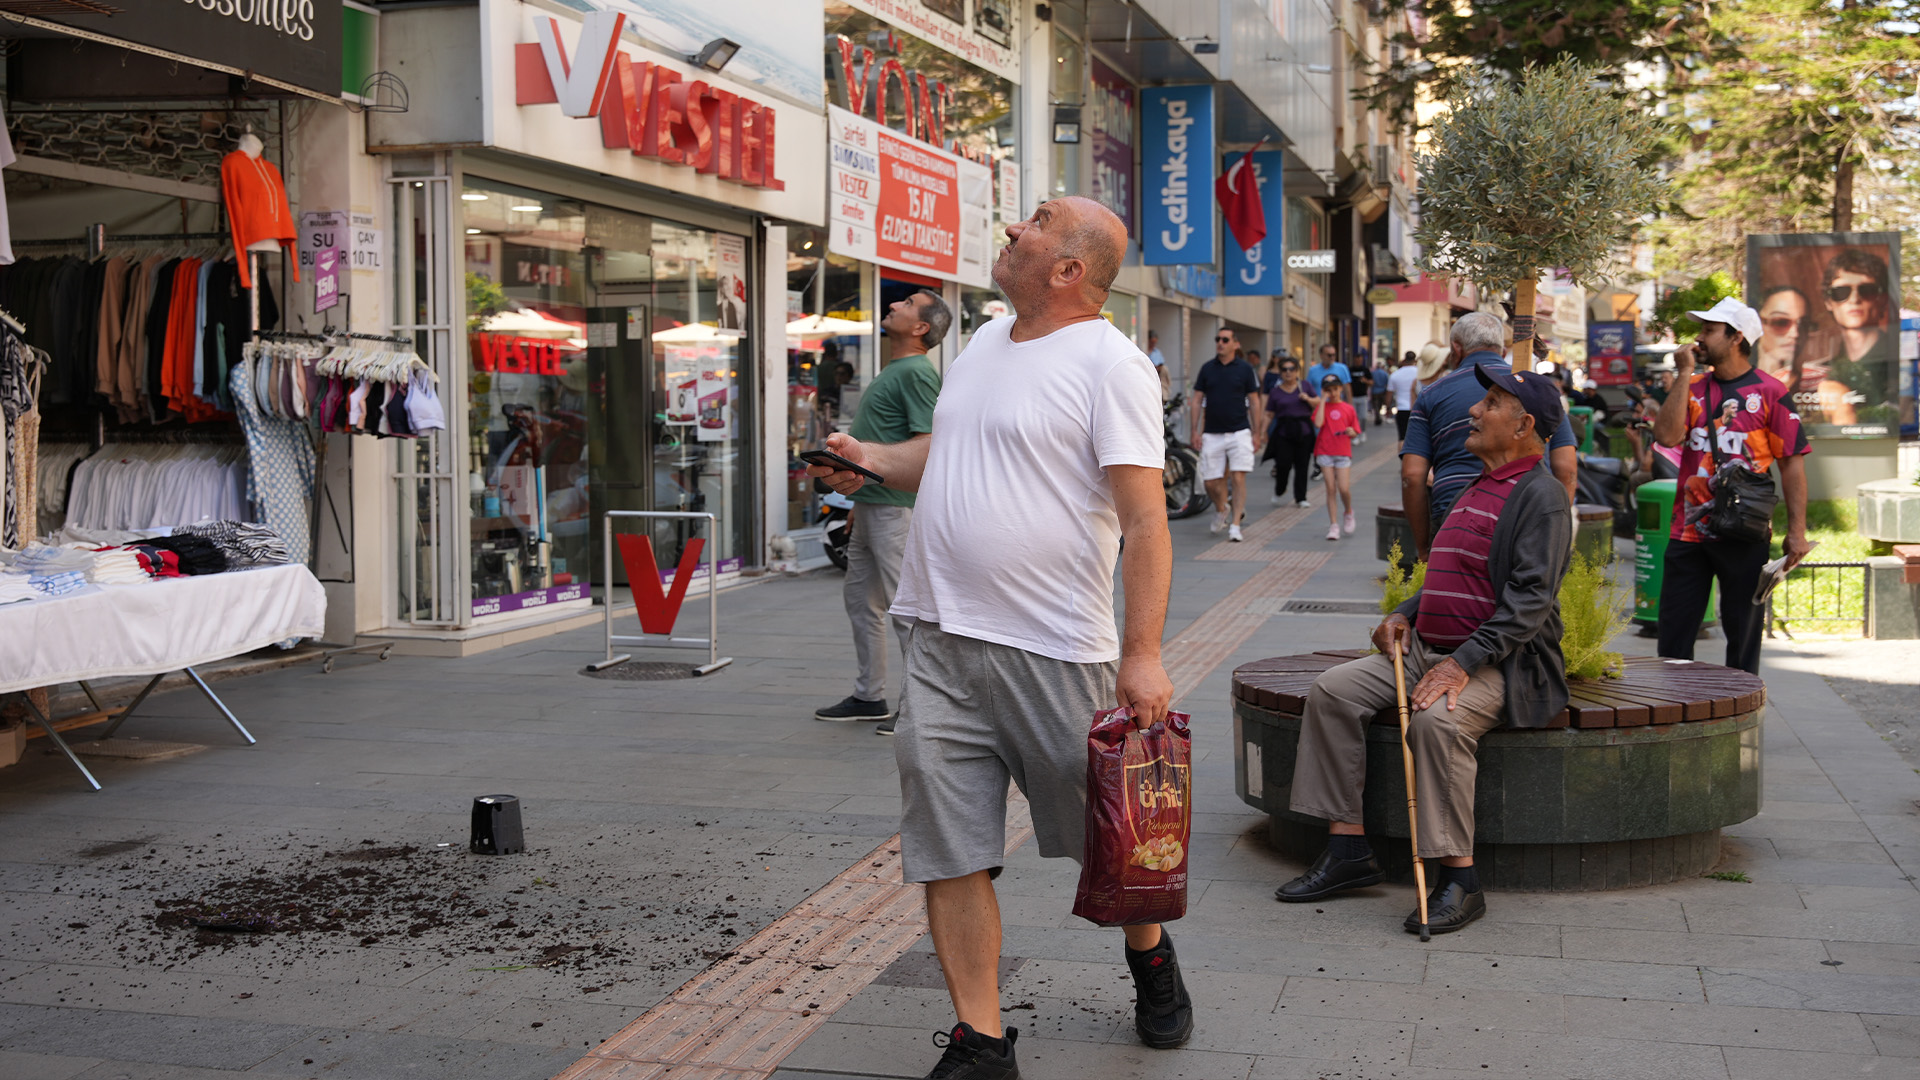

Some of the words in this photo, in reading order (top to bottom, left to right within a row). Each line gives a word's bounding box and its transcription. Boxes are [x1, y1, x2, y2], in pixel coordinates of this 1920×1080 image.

[600, 50, 785, 191] VESTEL
[844, 124, 868, 147] airfel
[834, 144, 876, 174] SAMSUNG
[838, 171, 869, 200] VESTEL
[1161, 100, 1194, 251] Çetinkaya
[842, 200, 866, 222] simfer
[907, 186, 920, 218] 15
[920, 191, 937, 223] AY
[312, 233, 334, 248] SU
[358, 231, 375, 245] ÇAY
[881, 214, 916, 247] ELDEN
[915, 223, 955, 257] TAKSİTLE
[352, 250, 365, 266] 10
[367, 251, 381, 267] TL
[469, 333, 568, 376] VESTEL
[556, 589, 581, 602] WORLD
[616, 533, 706, 635] V
[473, 603, 500, 616] WORLD
[522, 595, 548, 608] WORLD
